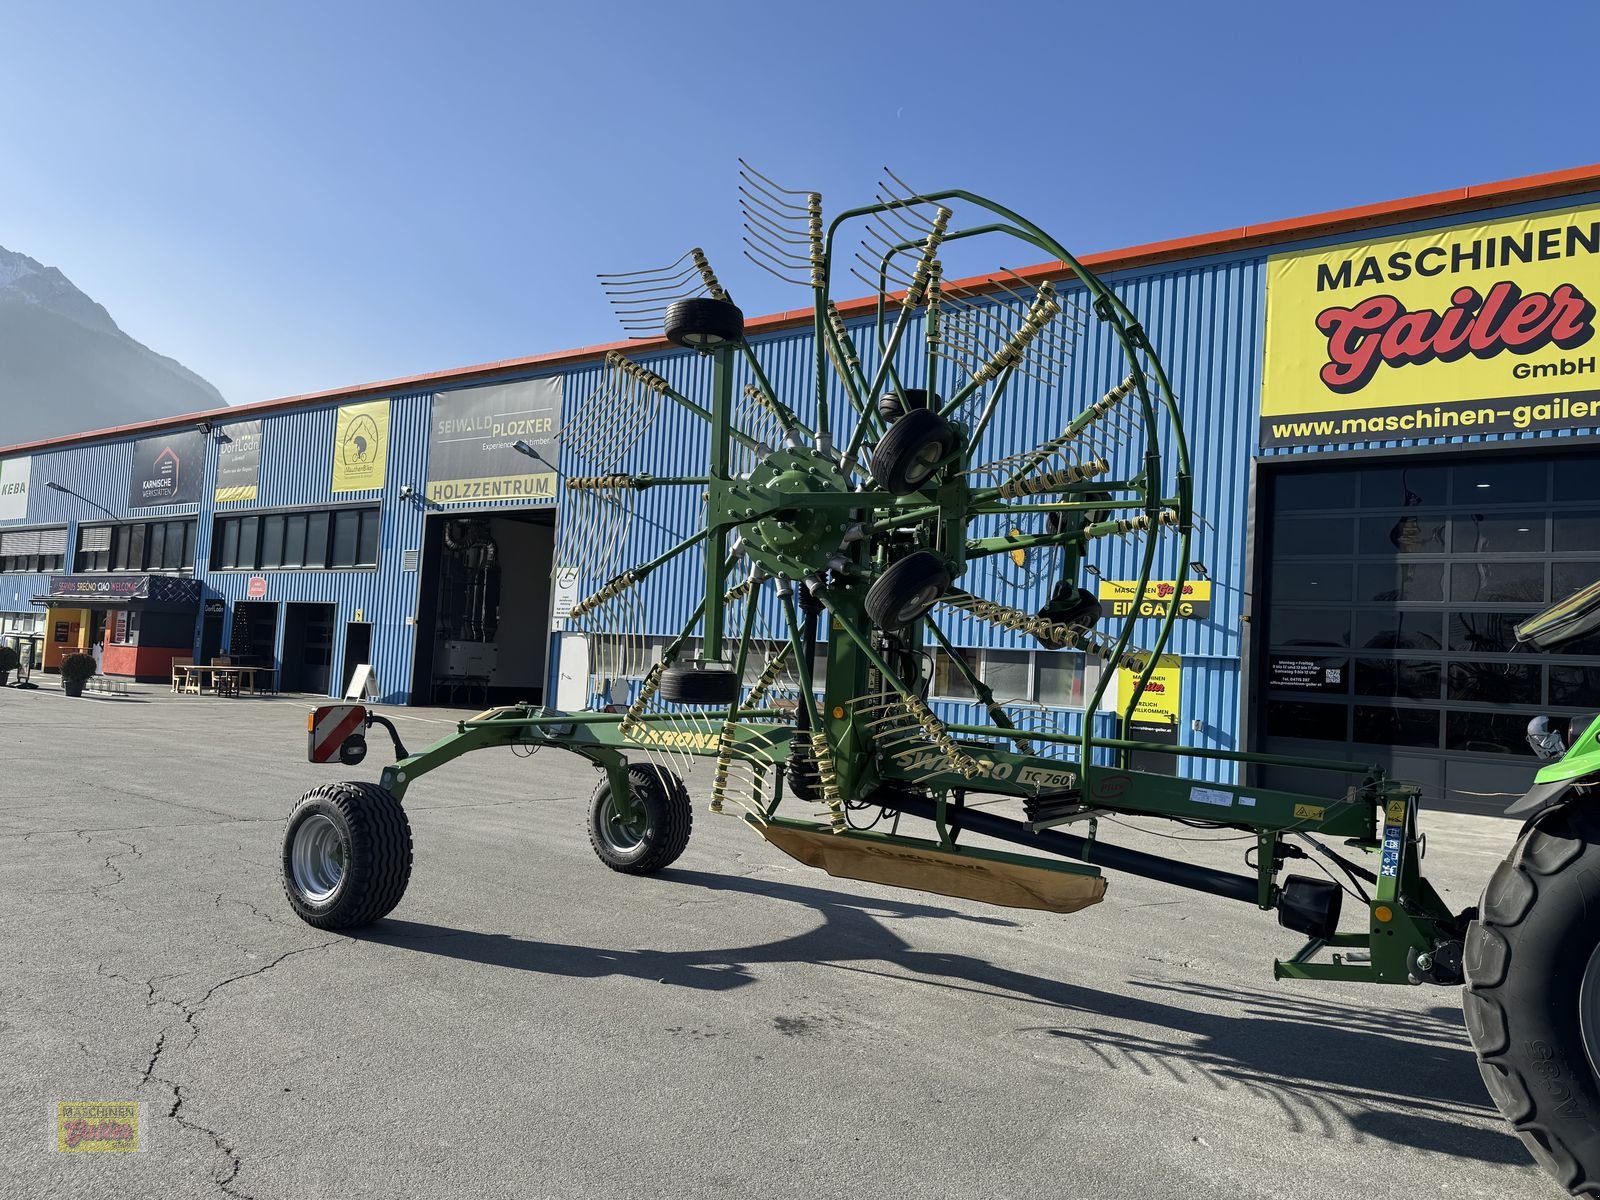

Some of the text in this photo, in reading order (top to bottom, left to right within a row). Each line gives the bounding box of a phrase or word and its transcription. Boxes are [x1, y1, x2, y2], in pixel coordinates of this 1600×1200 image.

[1317, 222, 1600, 292] MASCHINEN
[1315, 280, 1597, 394] Gailer
[1512, 356, 1596, 380] GmbH
[438, 415, 493, 434] SEIWALD
[1272, 397, 1600, 438] www.maschinen-gailer
[2, 482, 26, 495] KEBA
[143, 478, 172, 490] KARNISCHE
[433, 478, 549, 500] HOLZZENTRUM
[1157, 583, 1193, 598] Gaer
[556, 620, 560, 628] 1
[643, 729, 720, 750] KRONE
[896, 751, 1013, 781] SWARO
[1024, 770, 1070, 786] TC 760
